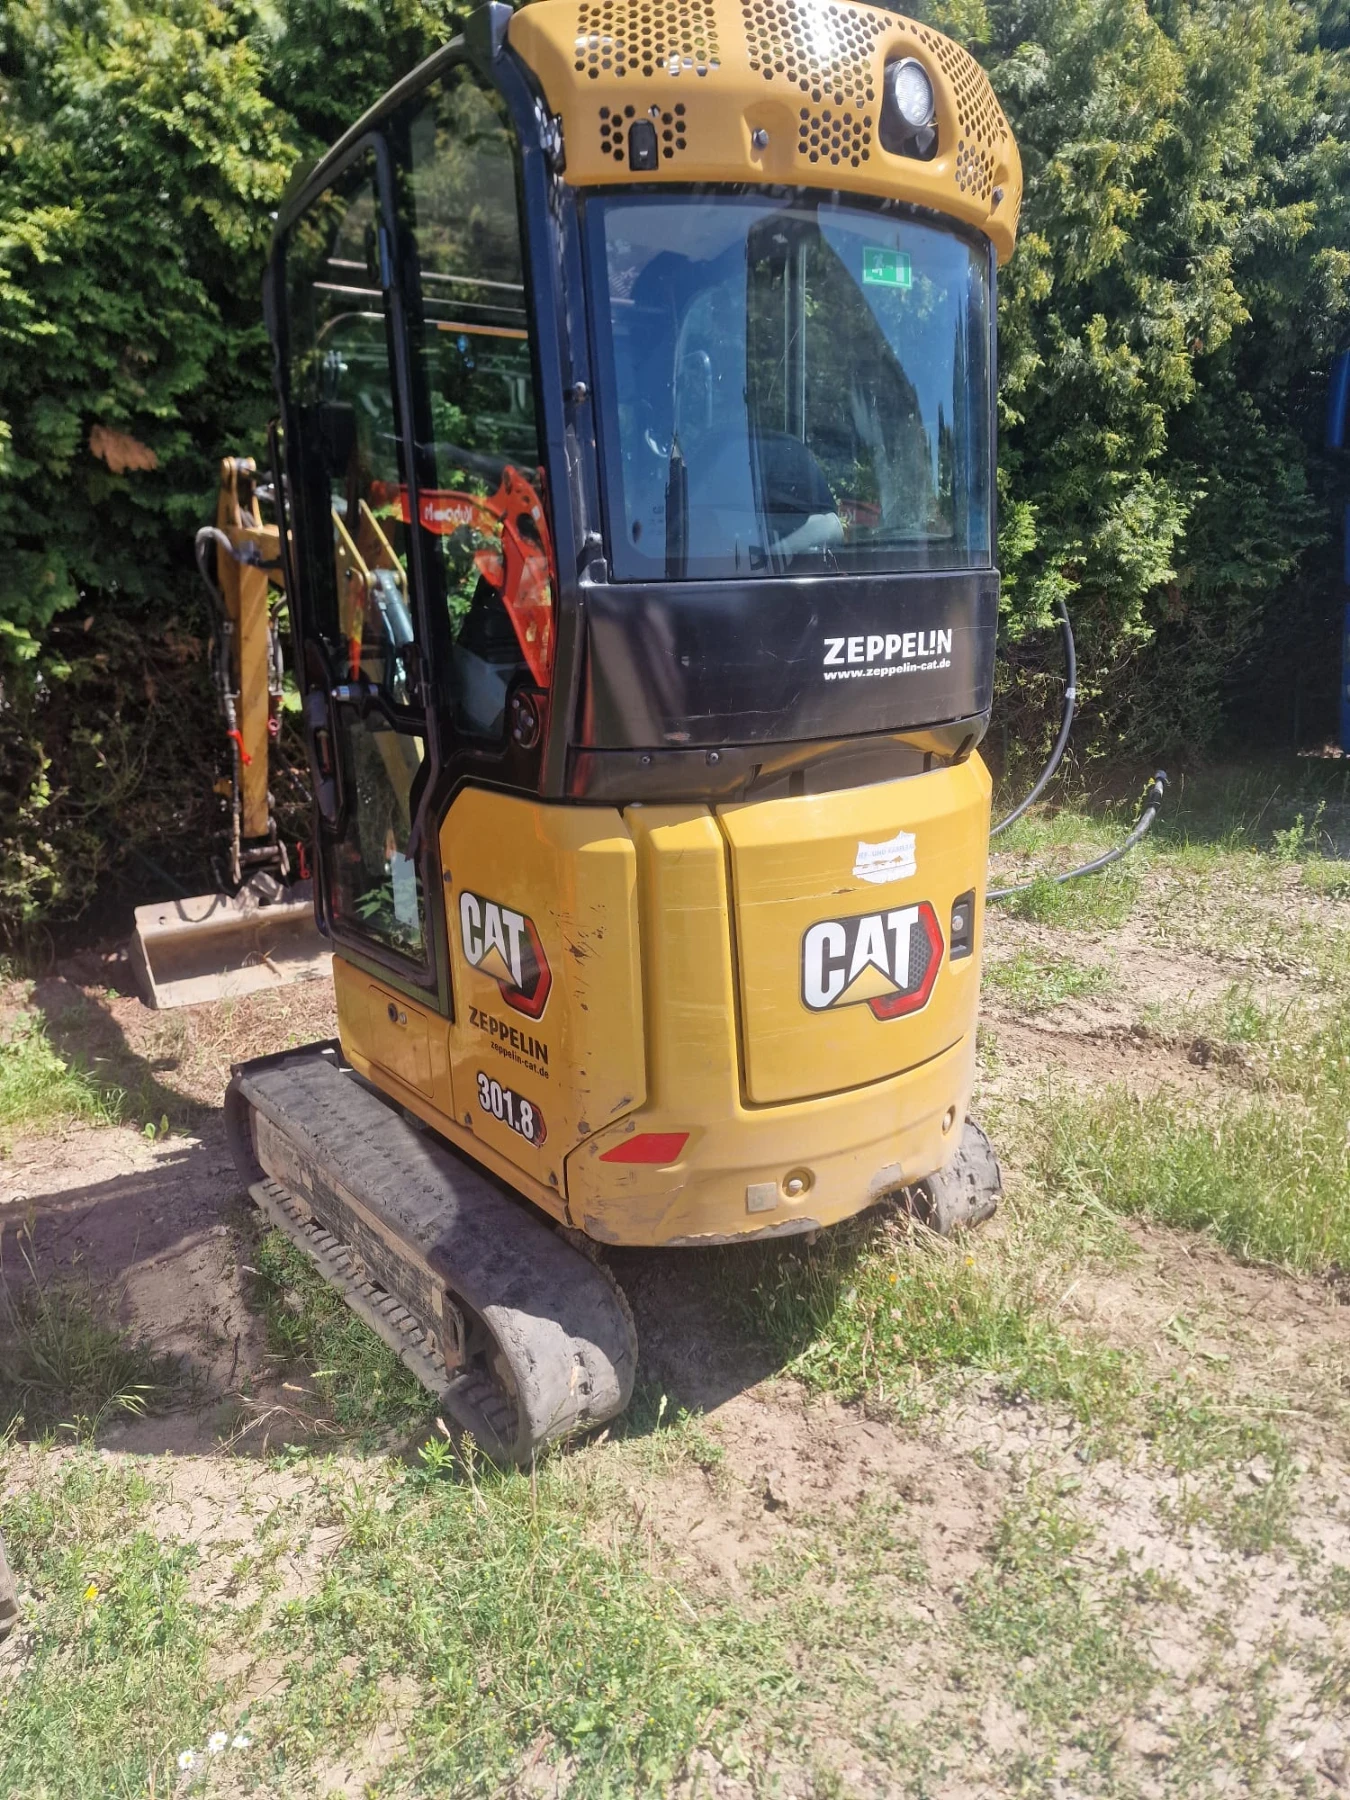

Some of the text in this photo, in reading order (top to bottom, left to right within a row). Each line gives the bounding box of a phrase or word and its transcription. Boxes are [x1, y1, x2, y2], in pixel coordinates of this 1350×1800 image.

[823, 628, 952, 665] ZEPPELIN
[823, 658, 951, 681] www.zeppelin-cat.de
[460, 892, 525, 989] CAT
[804, 905, 919, 1008] CAT
[468, 1005, 548, 1065] ZEPPELIN
[490, 1041, 550, 1080] zeppelin-cat.de
[477, 1073, 534, 1139] 301.8
